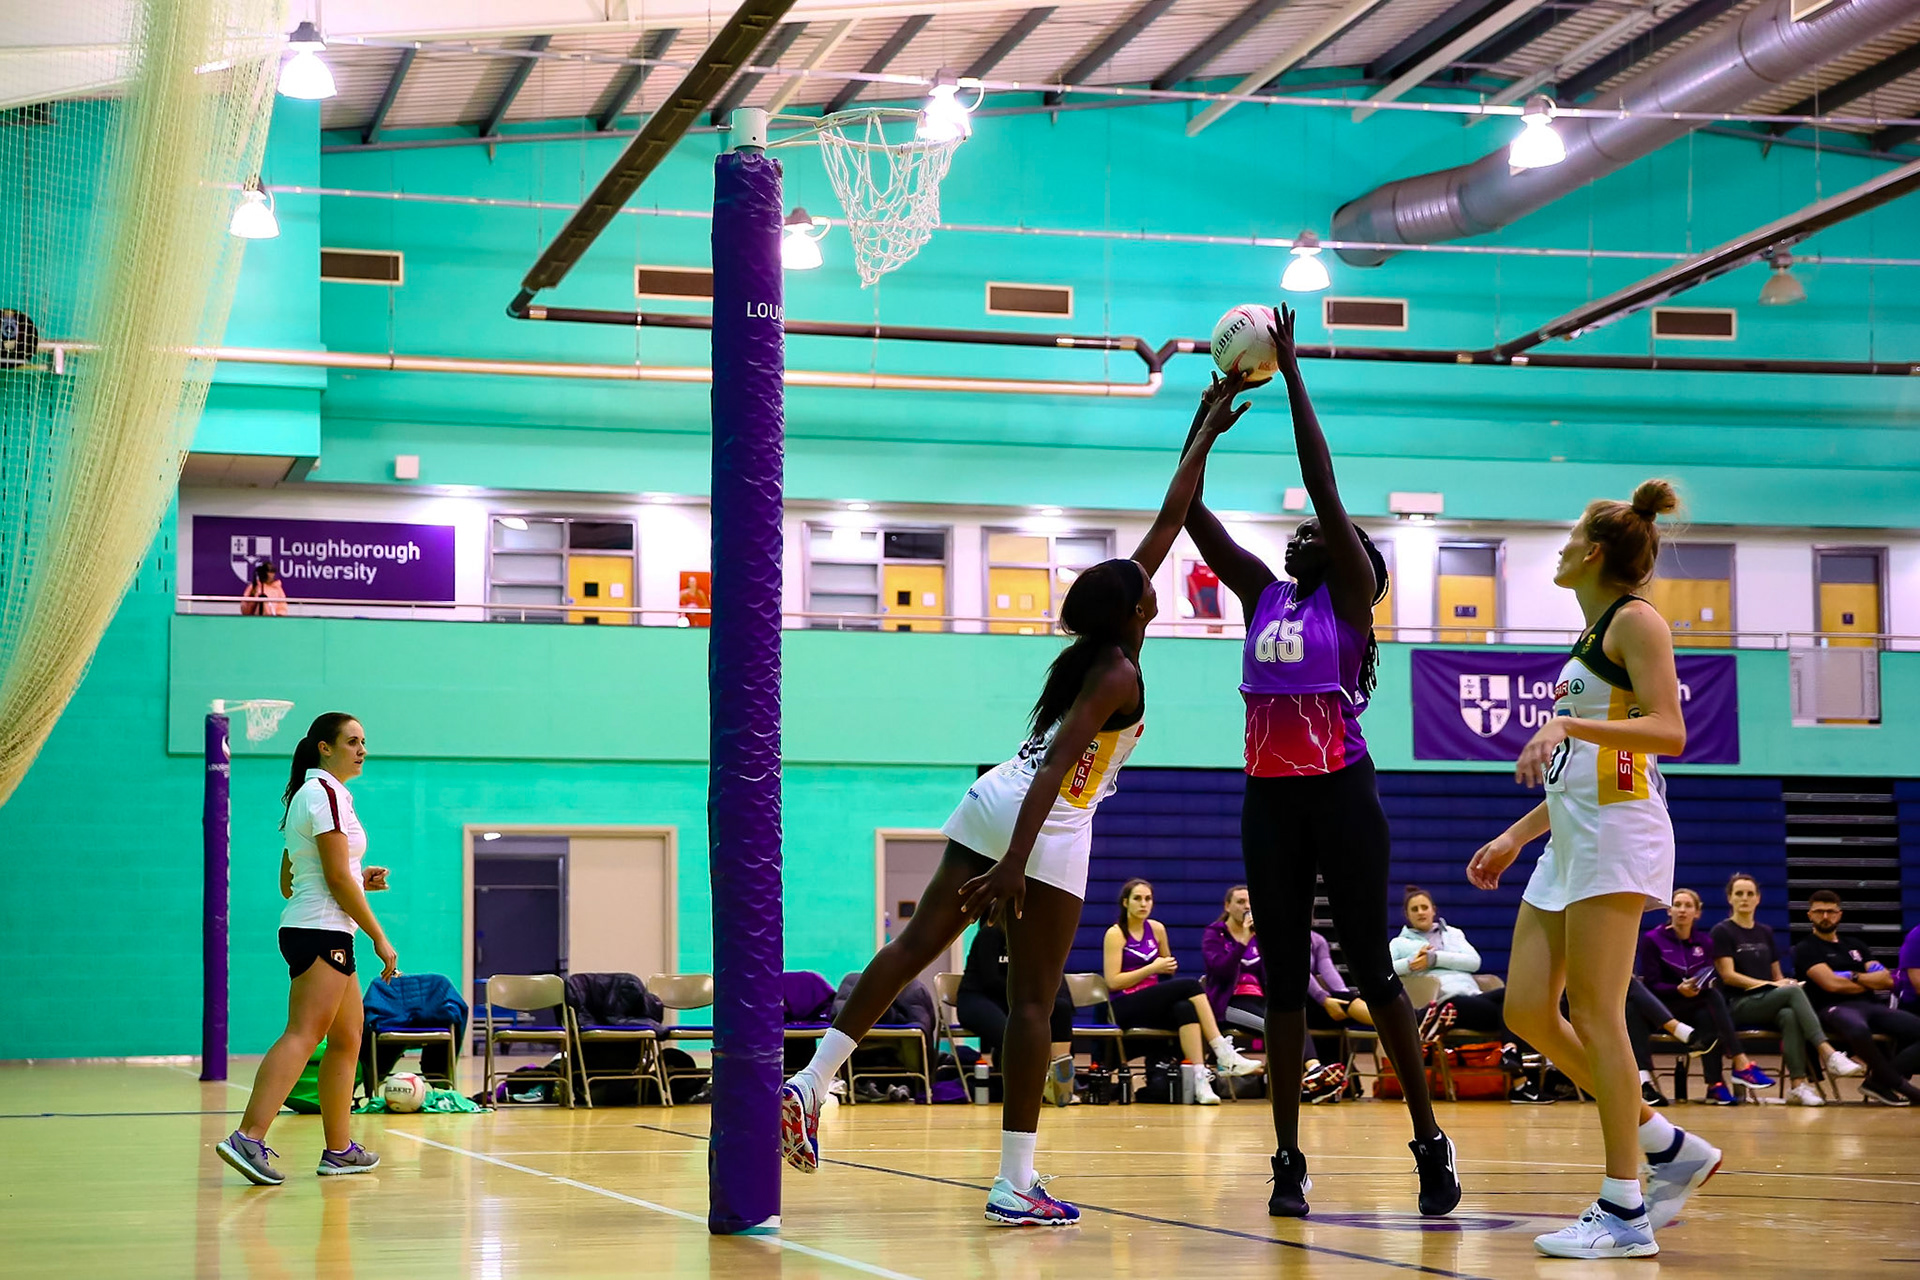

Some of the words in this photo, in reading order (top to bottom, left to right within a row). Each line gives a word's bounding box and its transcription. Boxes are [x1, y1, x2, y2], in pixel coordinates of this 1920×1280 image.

[279, 537, 421, 564] Loughborough
[279, 560, 377, 585] University
[1255, 618, 1304, 663] GS
